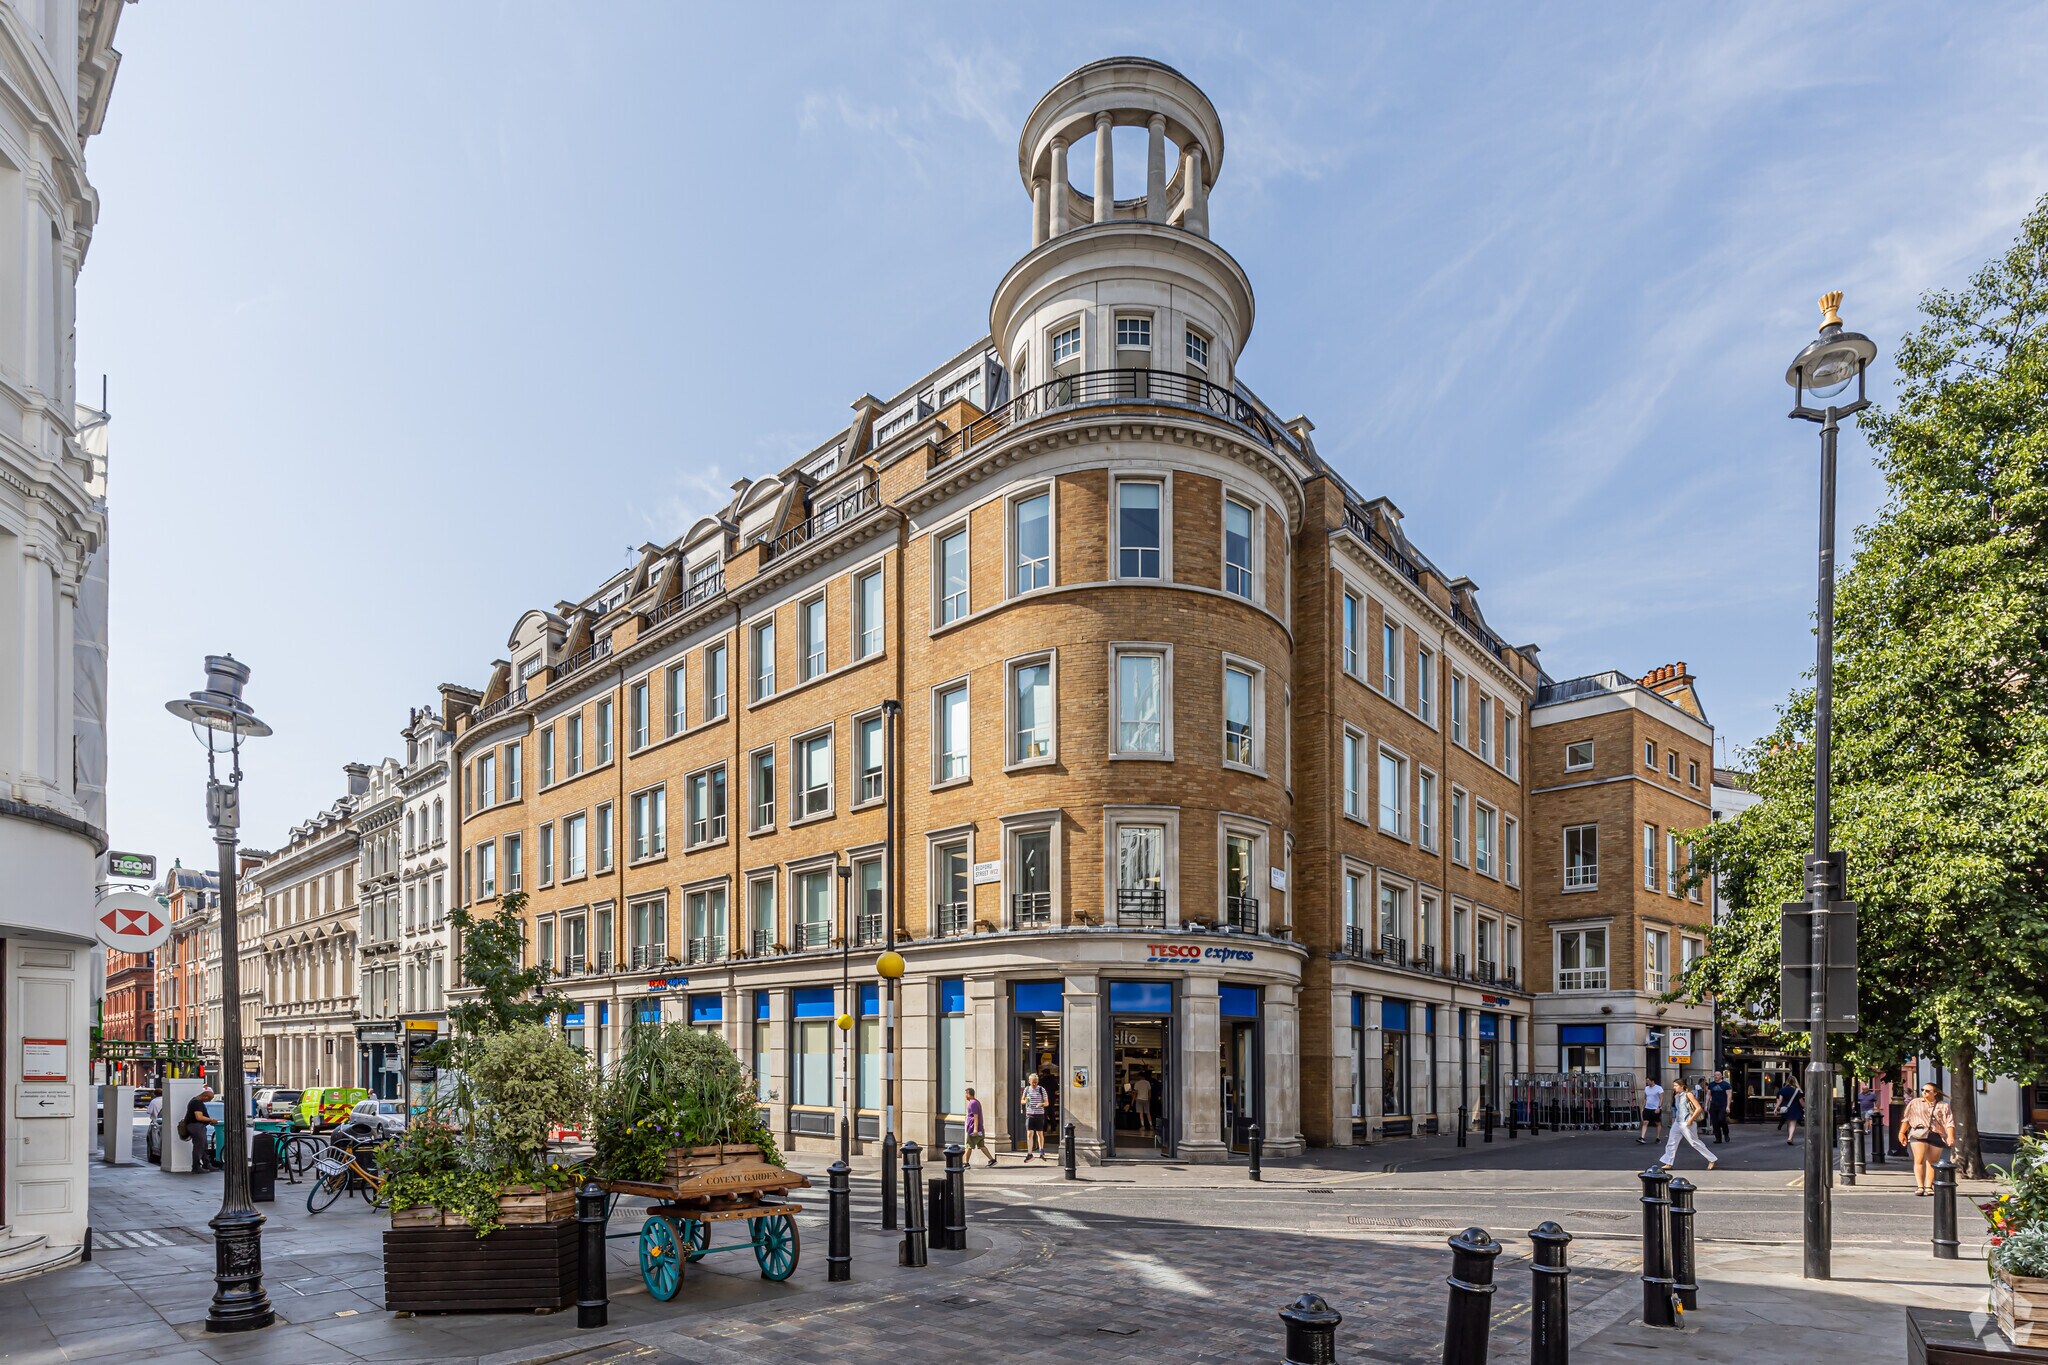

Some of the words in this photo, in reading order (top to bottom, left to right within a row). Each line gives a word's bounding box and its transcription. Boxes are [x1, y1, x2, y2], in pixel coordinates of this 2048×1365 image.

[111, 859, 152, 872] TIGON
[975, 863, 992, 872] BEDFORD
[975, 869, 989, 878] STREET
[1147, 943, 1201, 959] TESCO
[1204, 946, 1254, 963] express
[706, 1174, 743, 1185] COVENT
[743, 1171, 778, 1182] GARDEN
